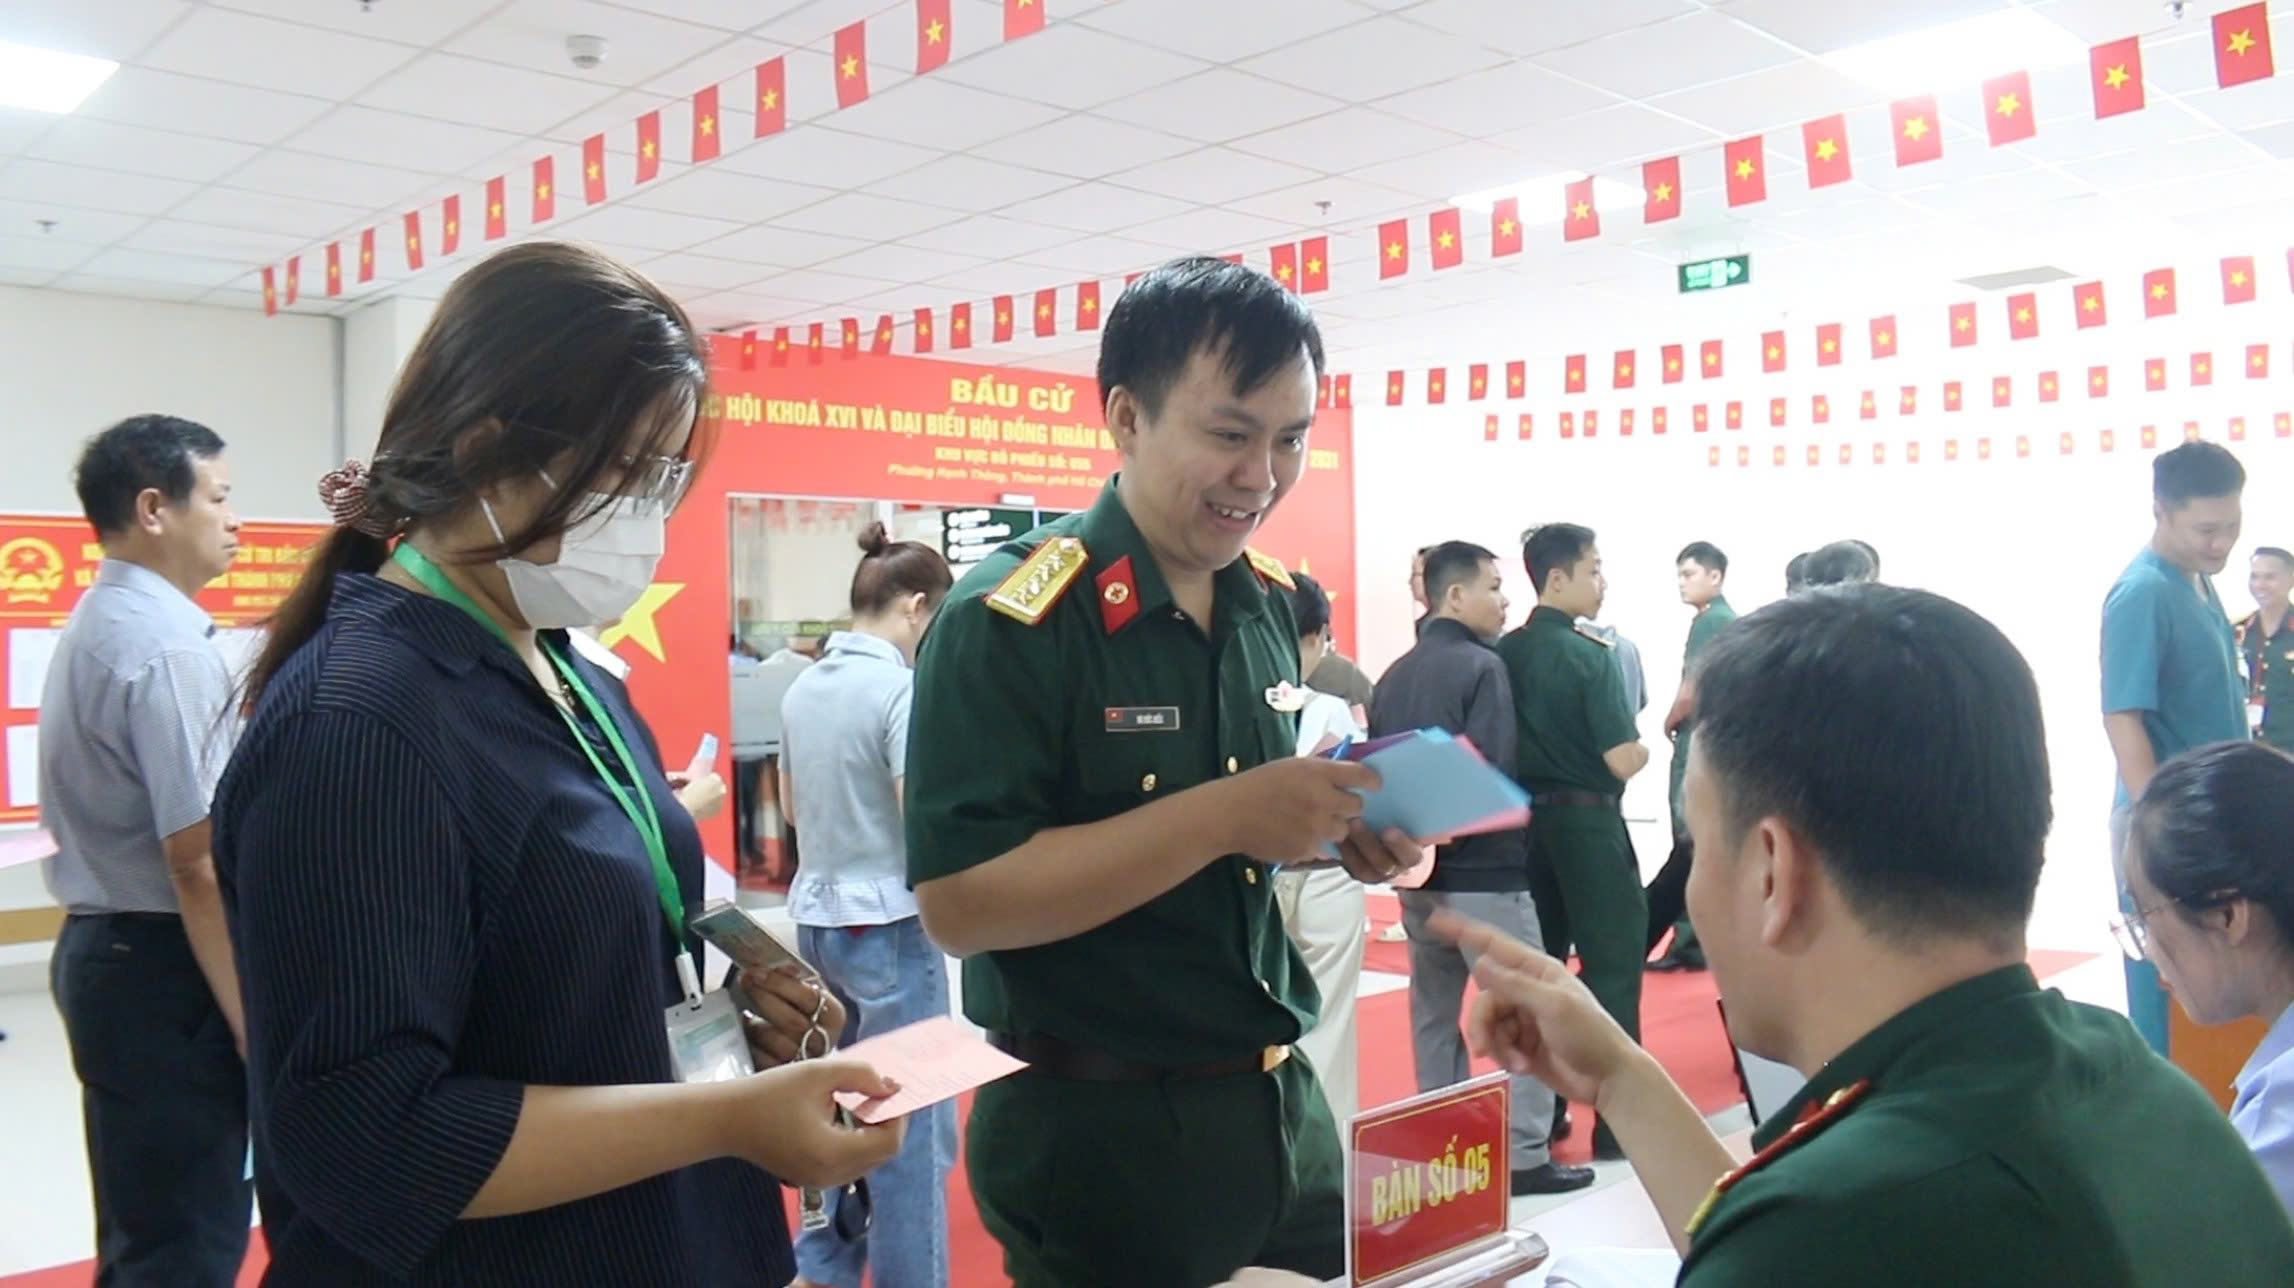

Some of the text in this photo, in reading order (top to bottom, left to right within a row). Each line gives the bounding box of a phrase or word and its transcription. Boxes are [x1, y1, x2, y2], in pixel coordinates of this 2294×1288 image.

[726, 393, 761, 426] HỘI
[766, 399, 820, 427] KHOÁ
[824, 404, 858, 430] XVI
[861, 405, 887, 432] VÀ
[891, 409, 922, 439] ĐẠI
[969, 413, 999, 445] HỘI
[1028, 382, 1075, 413] CỬ
[1372, 1134, 1490, 1226] BÀN SỐ 05
